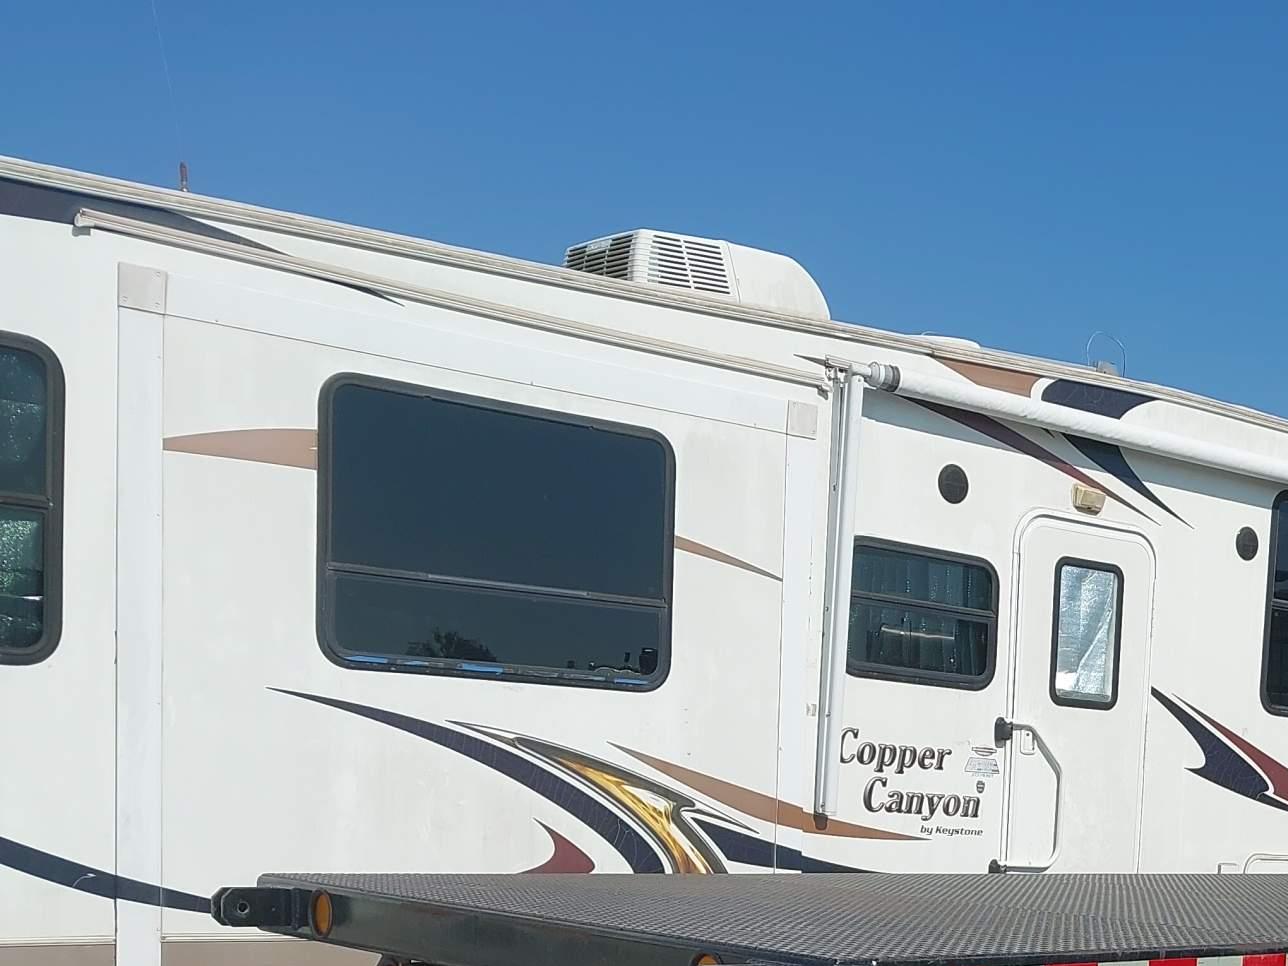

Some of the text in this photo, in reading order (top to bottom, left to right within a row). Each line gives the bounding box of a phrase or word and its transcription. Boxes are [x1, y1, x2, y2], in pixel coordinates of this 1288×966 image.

[839, 727, 952, 774] Copper
[863, 776, 981, 821] Canyon
[920, 824, 983, 837] by Keystone
